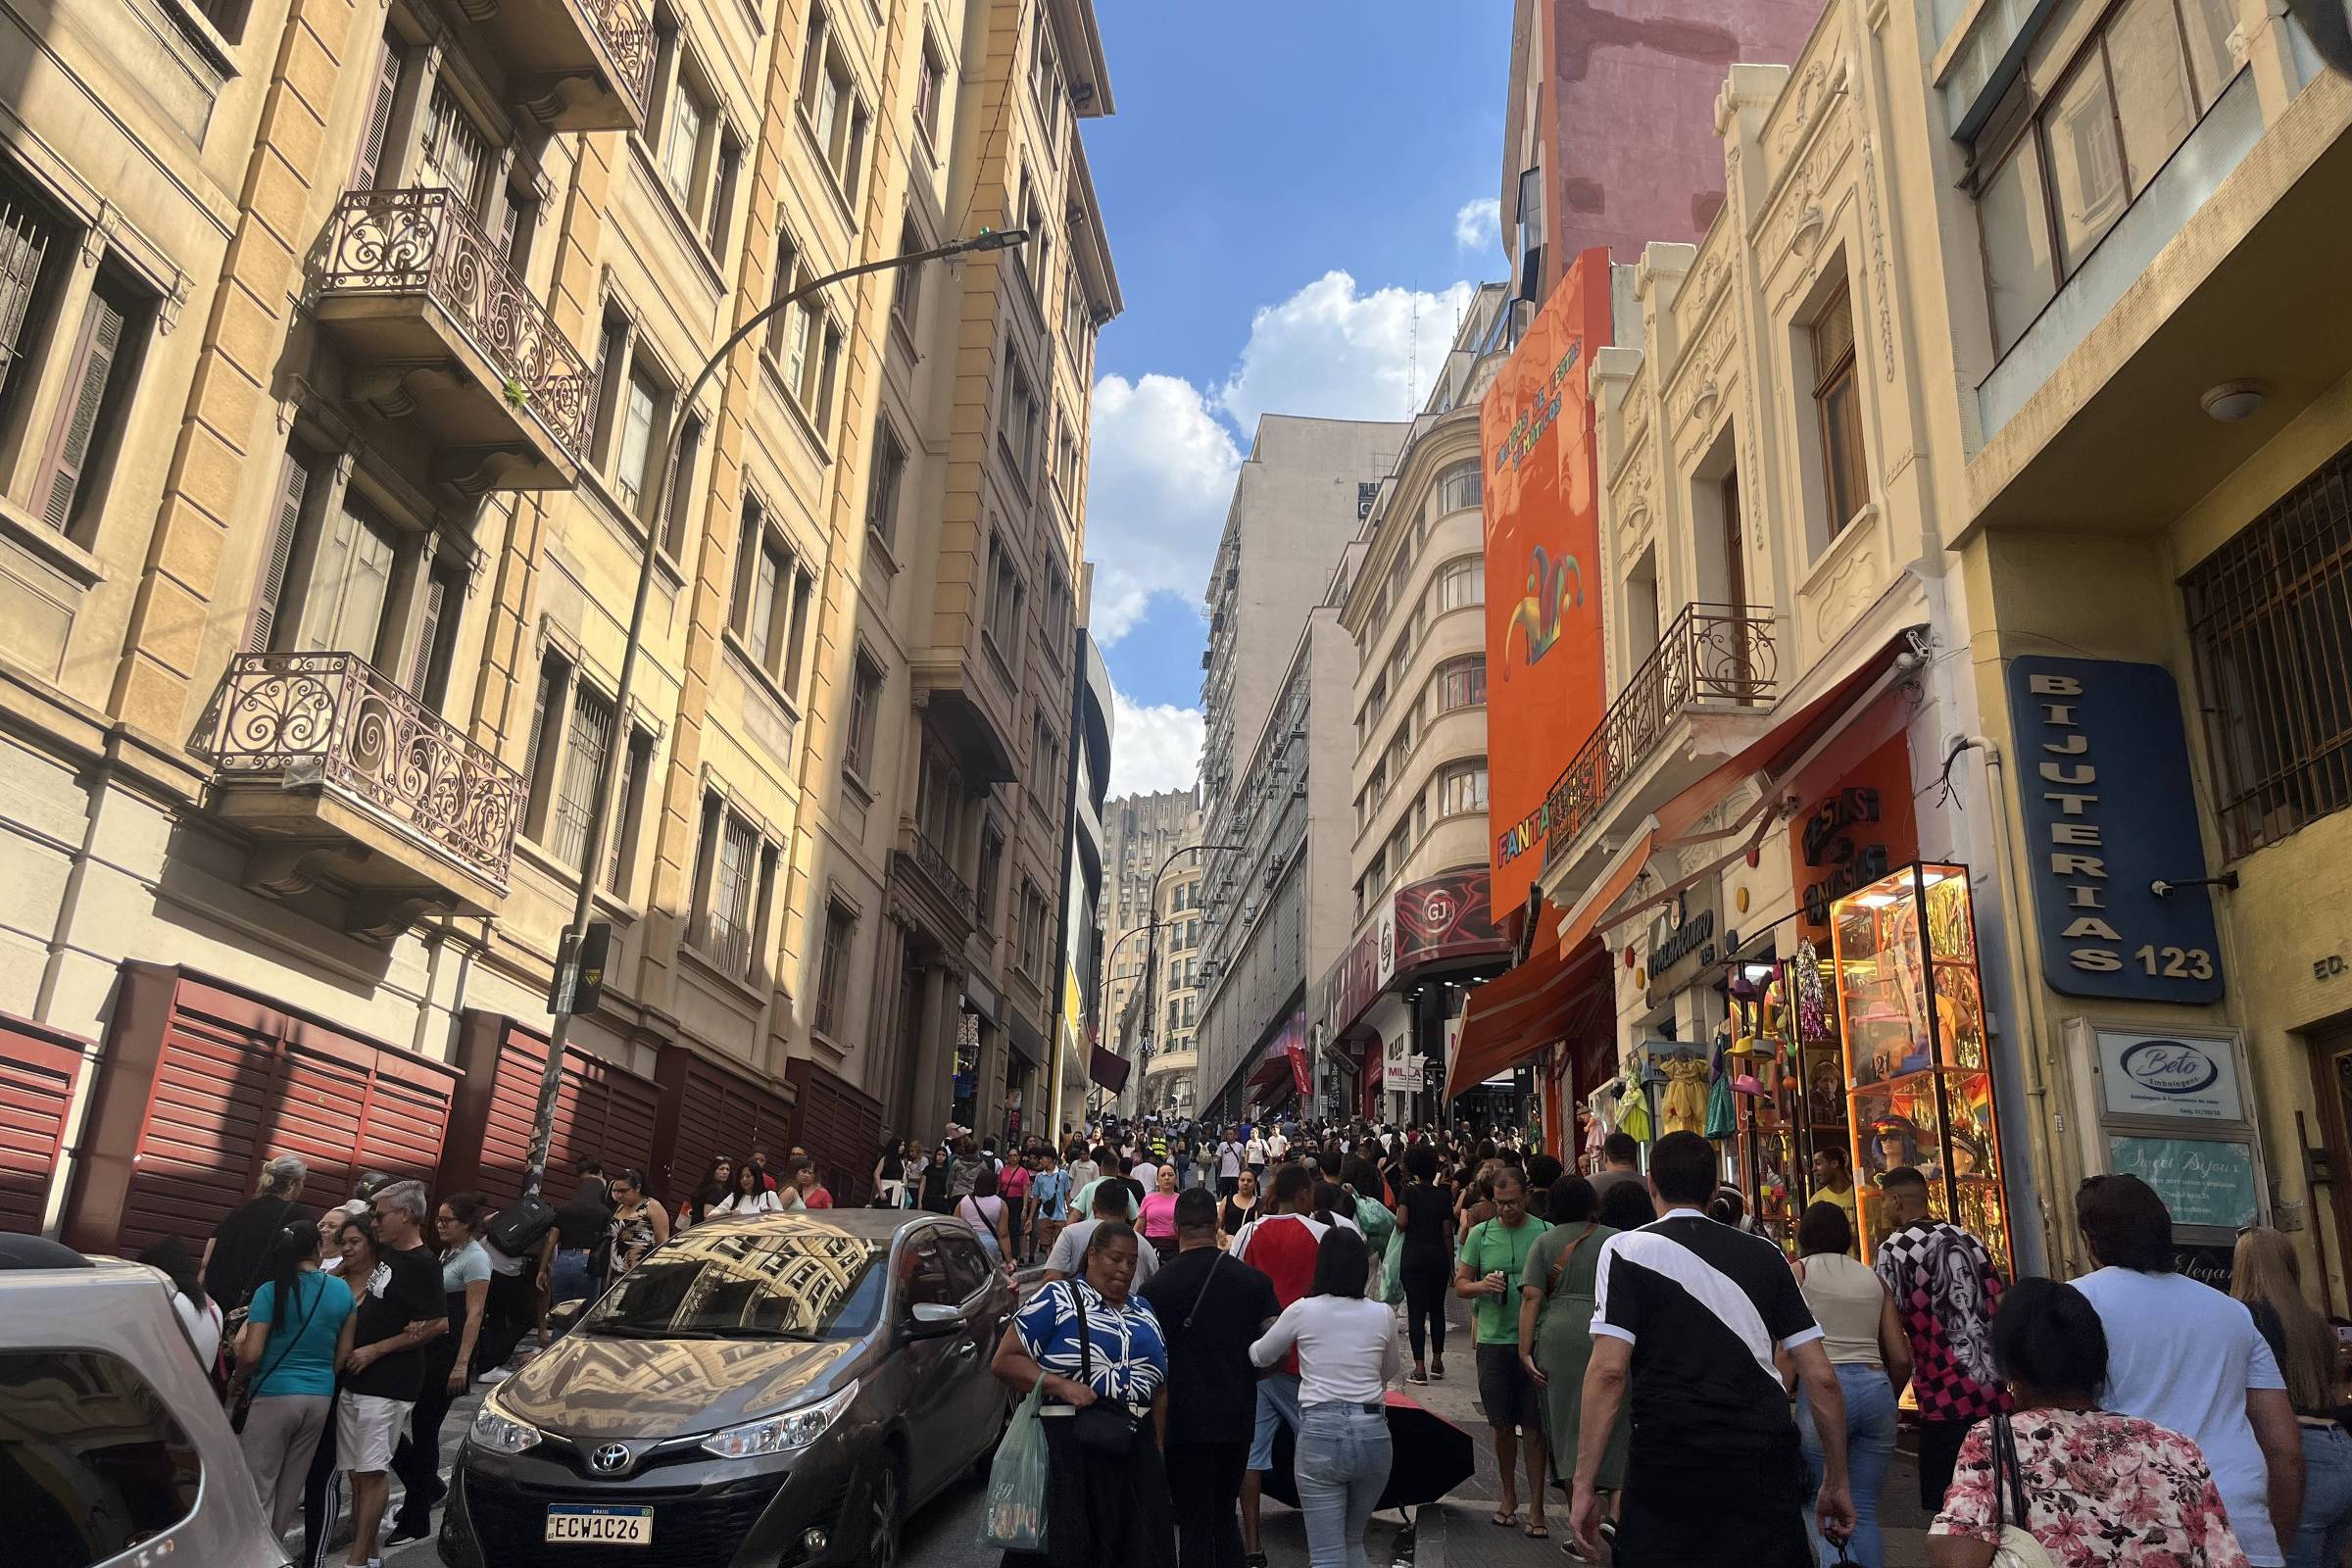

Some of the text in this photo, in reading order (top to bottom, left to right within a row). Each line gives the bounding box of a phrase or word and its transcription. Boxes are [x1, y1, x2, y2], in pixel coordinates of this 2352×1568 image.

[2030, 674, 2124, 972] BIJUTERIAS
[1427, 901, 1446, 921] GJ
[2134, 944, 2214, 980] 123
[2136, 1049, 2200, 1077] Beto
[2124, 1146, 2239, 1177] Sweet Bijoux
[555, 1517, 639, 1540] ECW1C26
